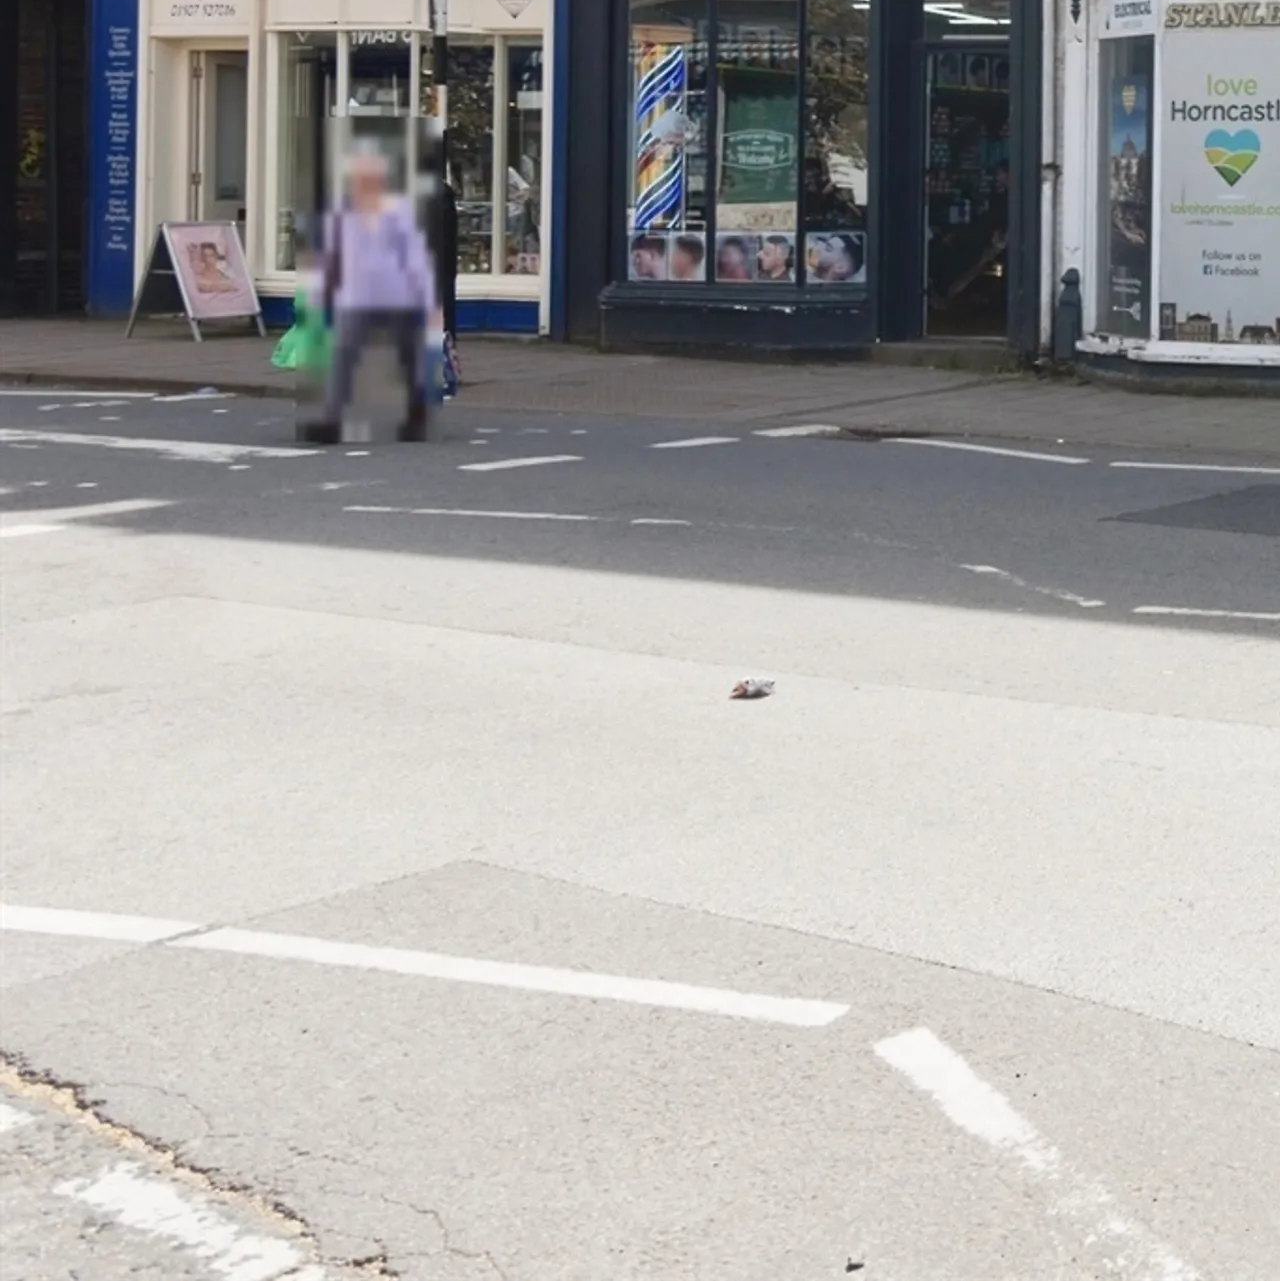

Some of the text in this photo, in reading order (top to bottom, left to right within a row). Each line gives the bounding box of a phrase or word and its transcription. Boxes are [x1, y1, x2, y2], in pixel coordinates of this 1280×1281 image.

[1206, 74, 1258, 96] love
[1202, 249, 1262, 262] Follow us on
[1214, 265, 1260, 277] Facebook
